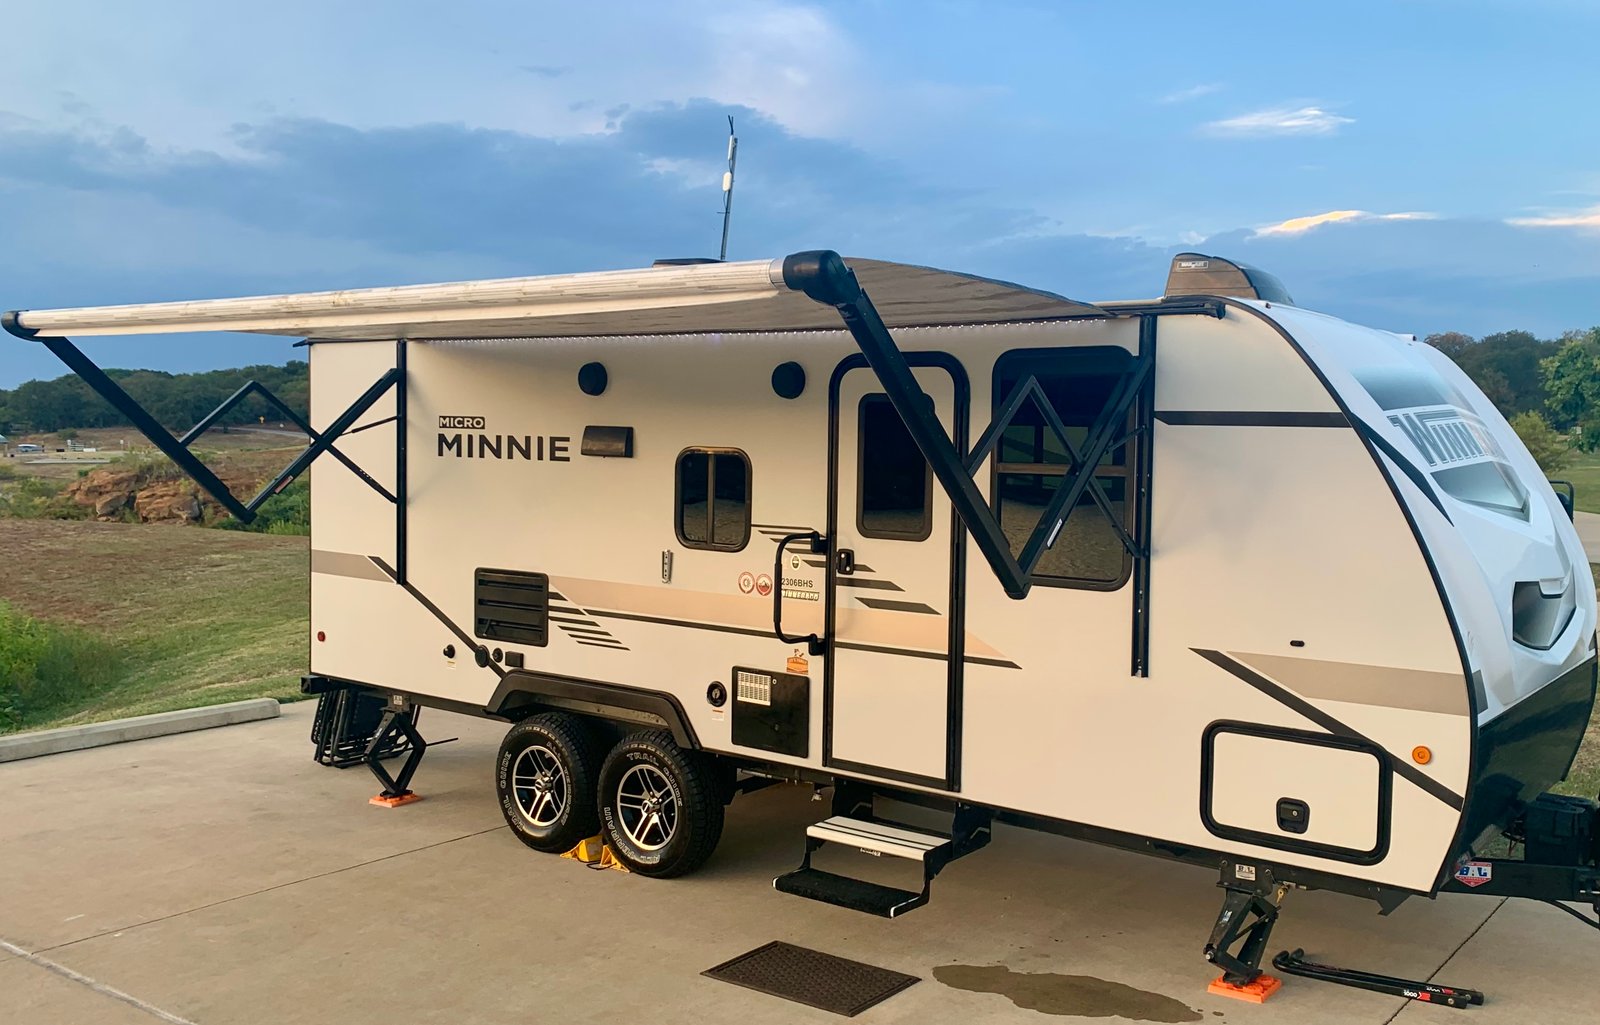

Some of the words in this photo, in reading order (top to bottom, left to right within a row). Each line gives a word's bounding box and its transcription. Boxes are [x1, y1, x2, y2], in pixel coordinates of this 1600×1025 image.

[439, 416, 485, 429] MICRO
[437, 433, 571, 462] MINNIE
[781, 577, 814, 588] 2306BHS
[500, 751, 512, 789] GUIDE
[626, 751, 660, 767] TRAIL
[662, 766, 683, 807] GUIDE
[502, 794, 524, 832] TRAIL
